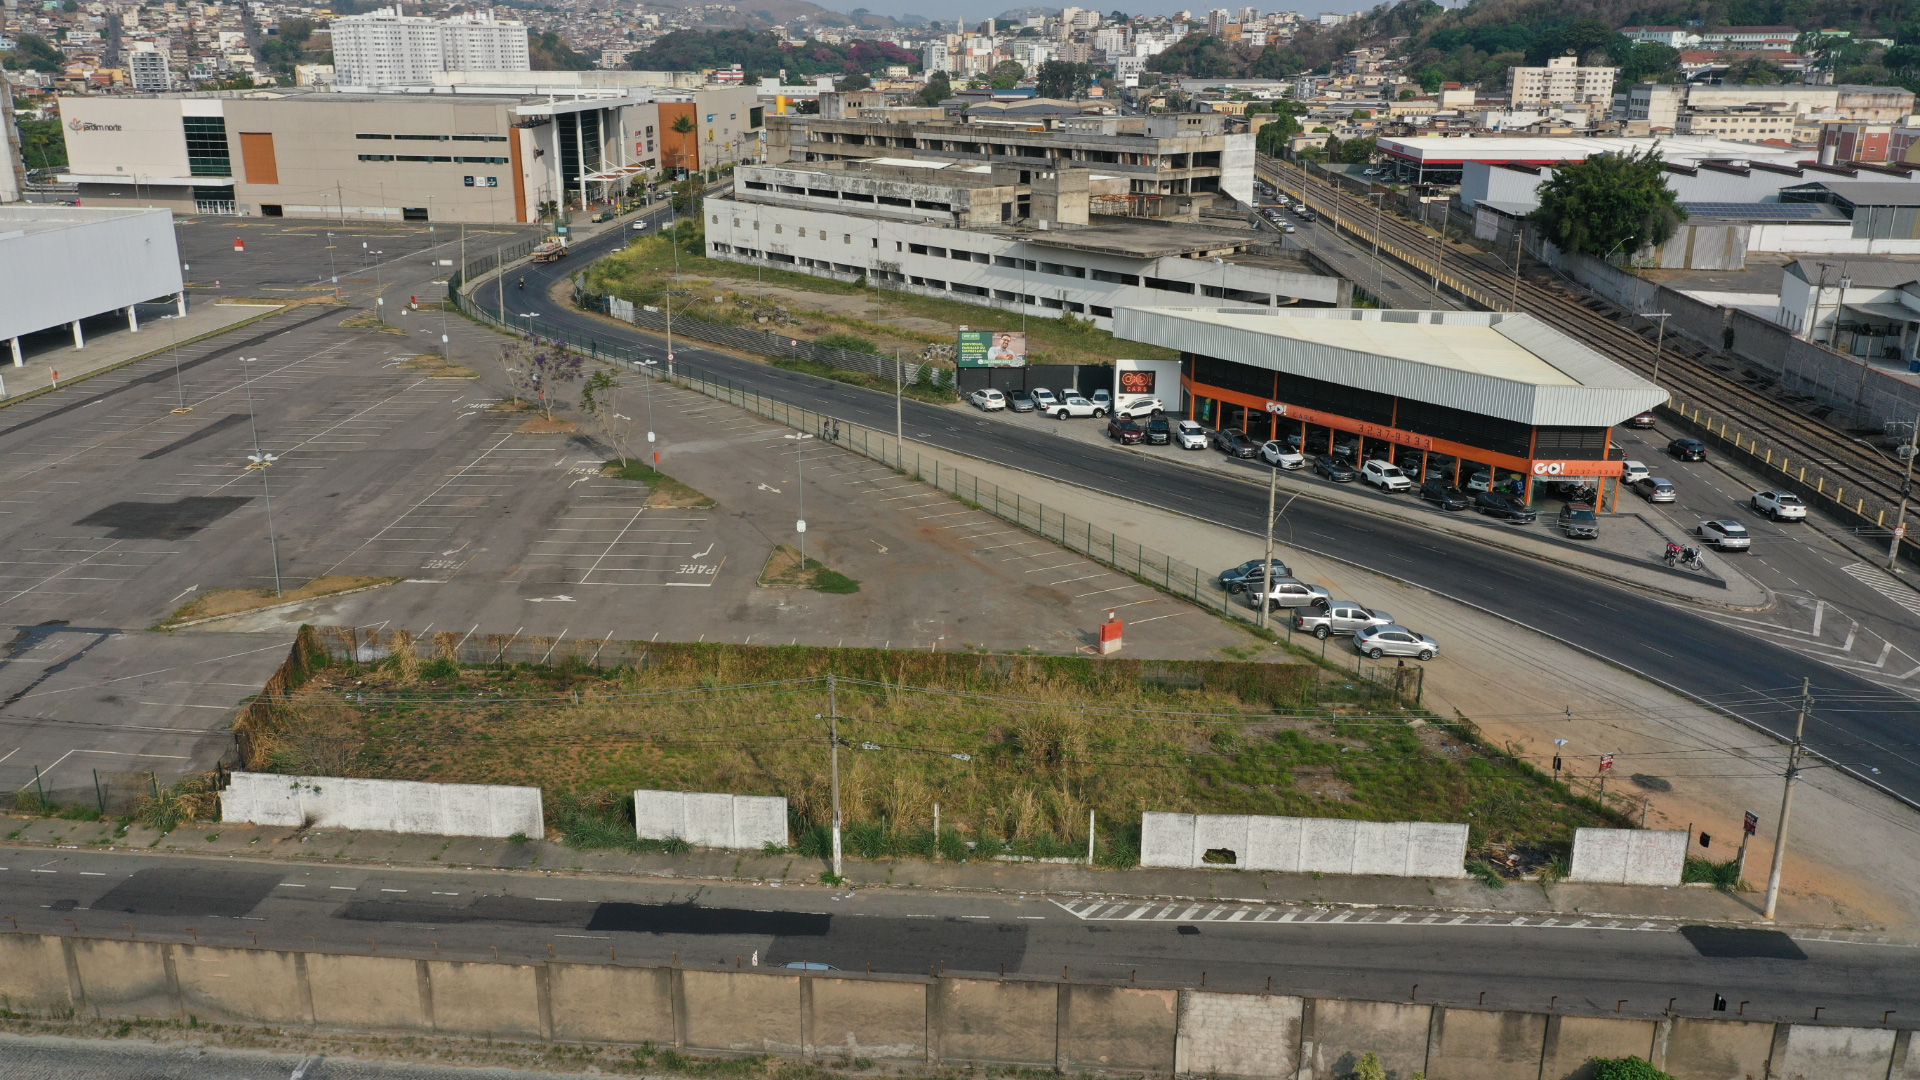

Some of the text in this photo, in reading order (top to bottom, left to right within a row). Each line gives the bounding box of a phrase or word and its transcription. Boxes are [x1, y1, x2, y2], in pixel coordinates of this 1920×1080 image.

[84, 123, 122, 132] jardim norte
[1265, 401, 1288, 416] GO!
[1358, 423, 1431, 449] 3237-9333
[568, 467, 600, 475] PARE
[1533, 462, 1566, 475] GO!
[421, 559, 466, 569] PARE
[675, 564, 717, 575] PARE
